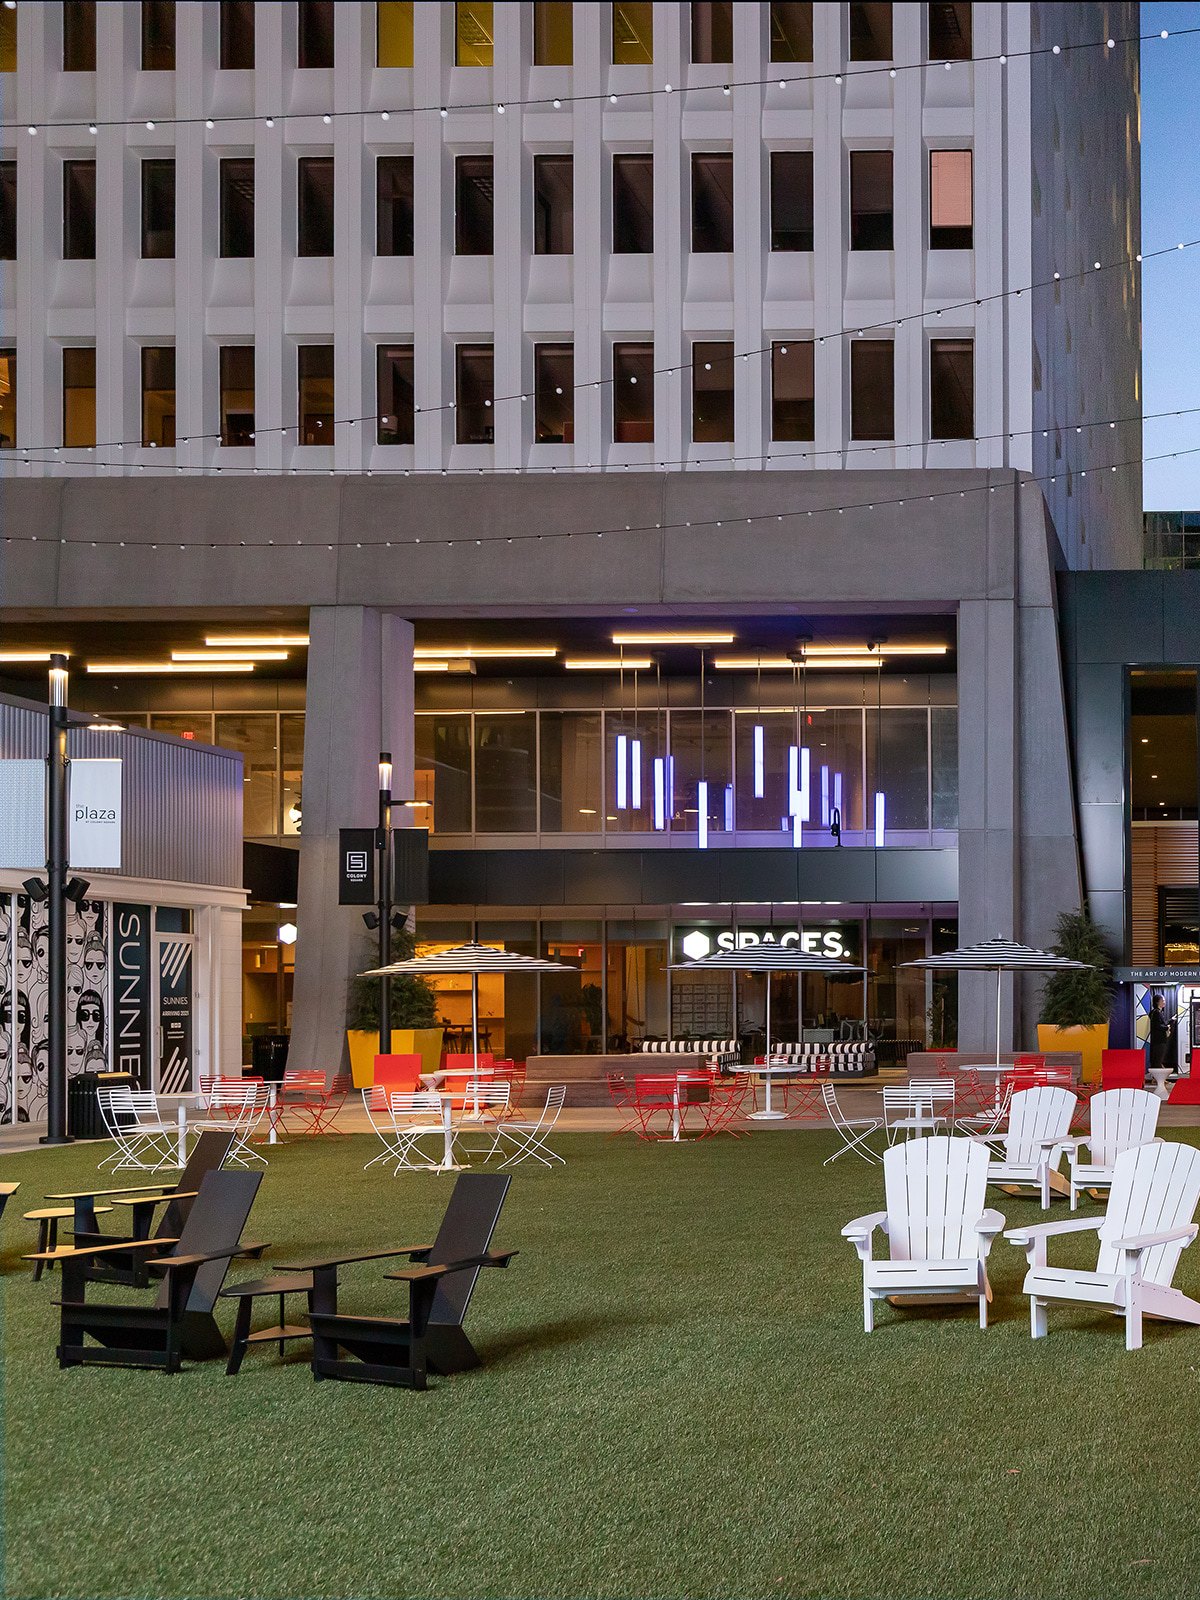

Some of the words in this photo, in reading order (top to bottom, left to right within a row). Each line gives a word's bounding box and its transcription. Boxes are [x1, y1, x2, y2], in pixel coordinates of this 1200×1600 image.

[75, 806, 116, 822] plaza
[119, 911, 141, 1095] SUNNIE
[162, 996, 189, 1005] SUNNIES
